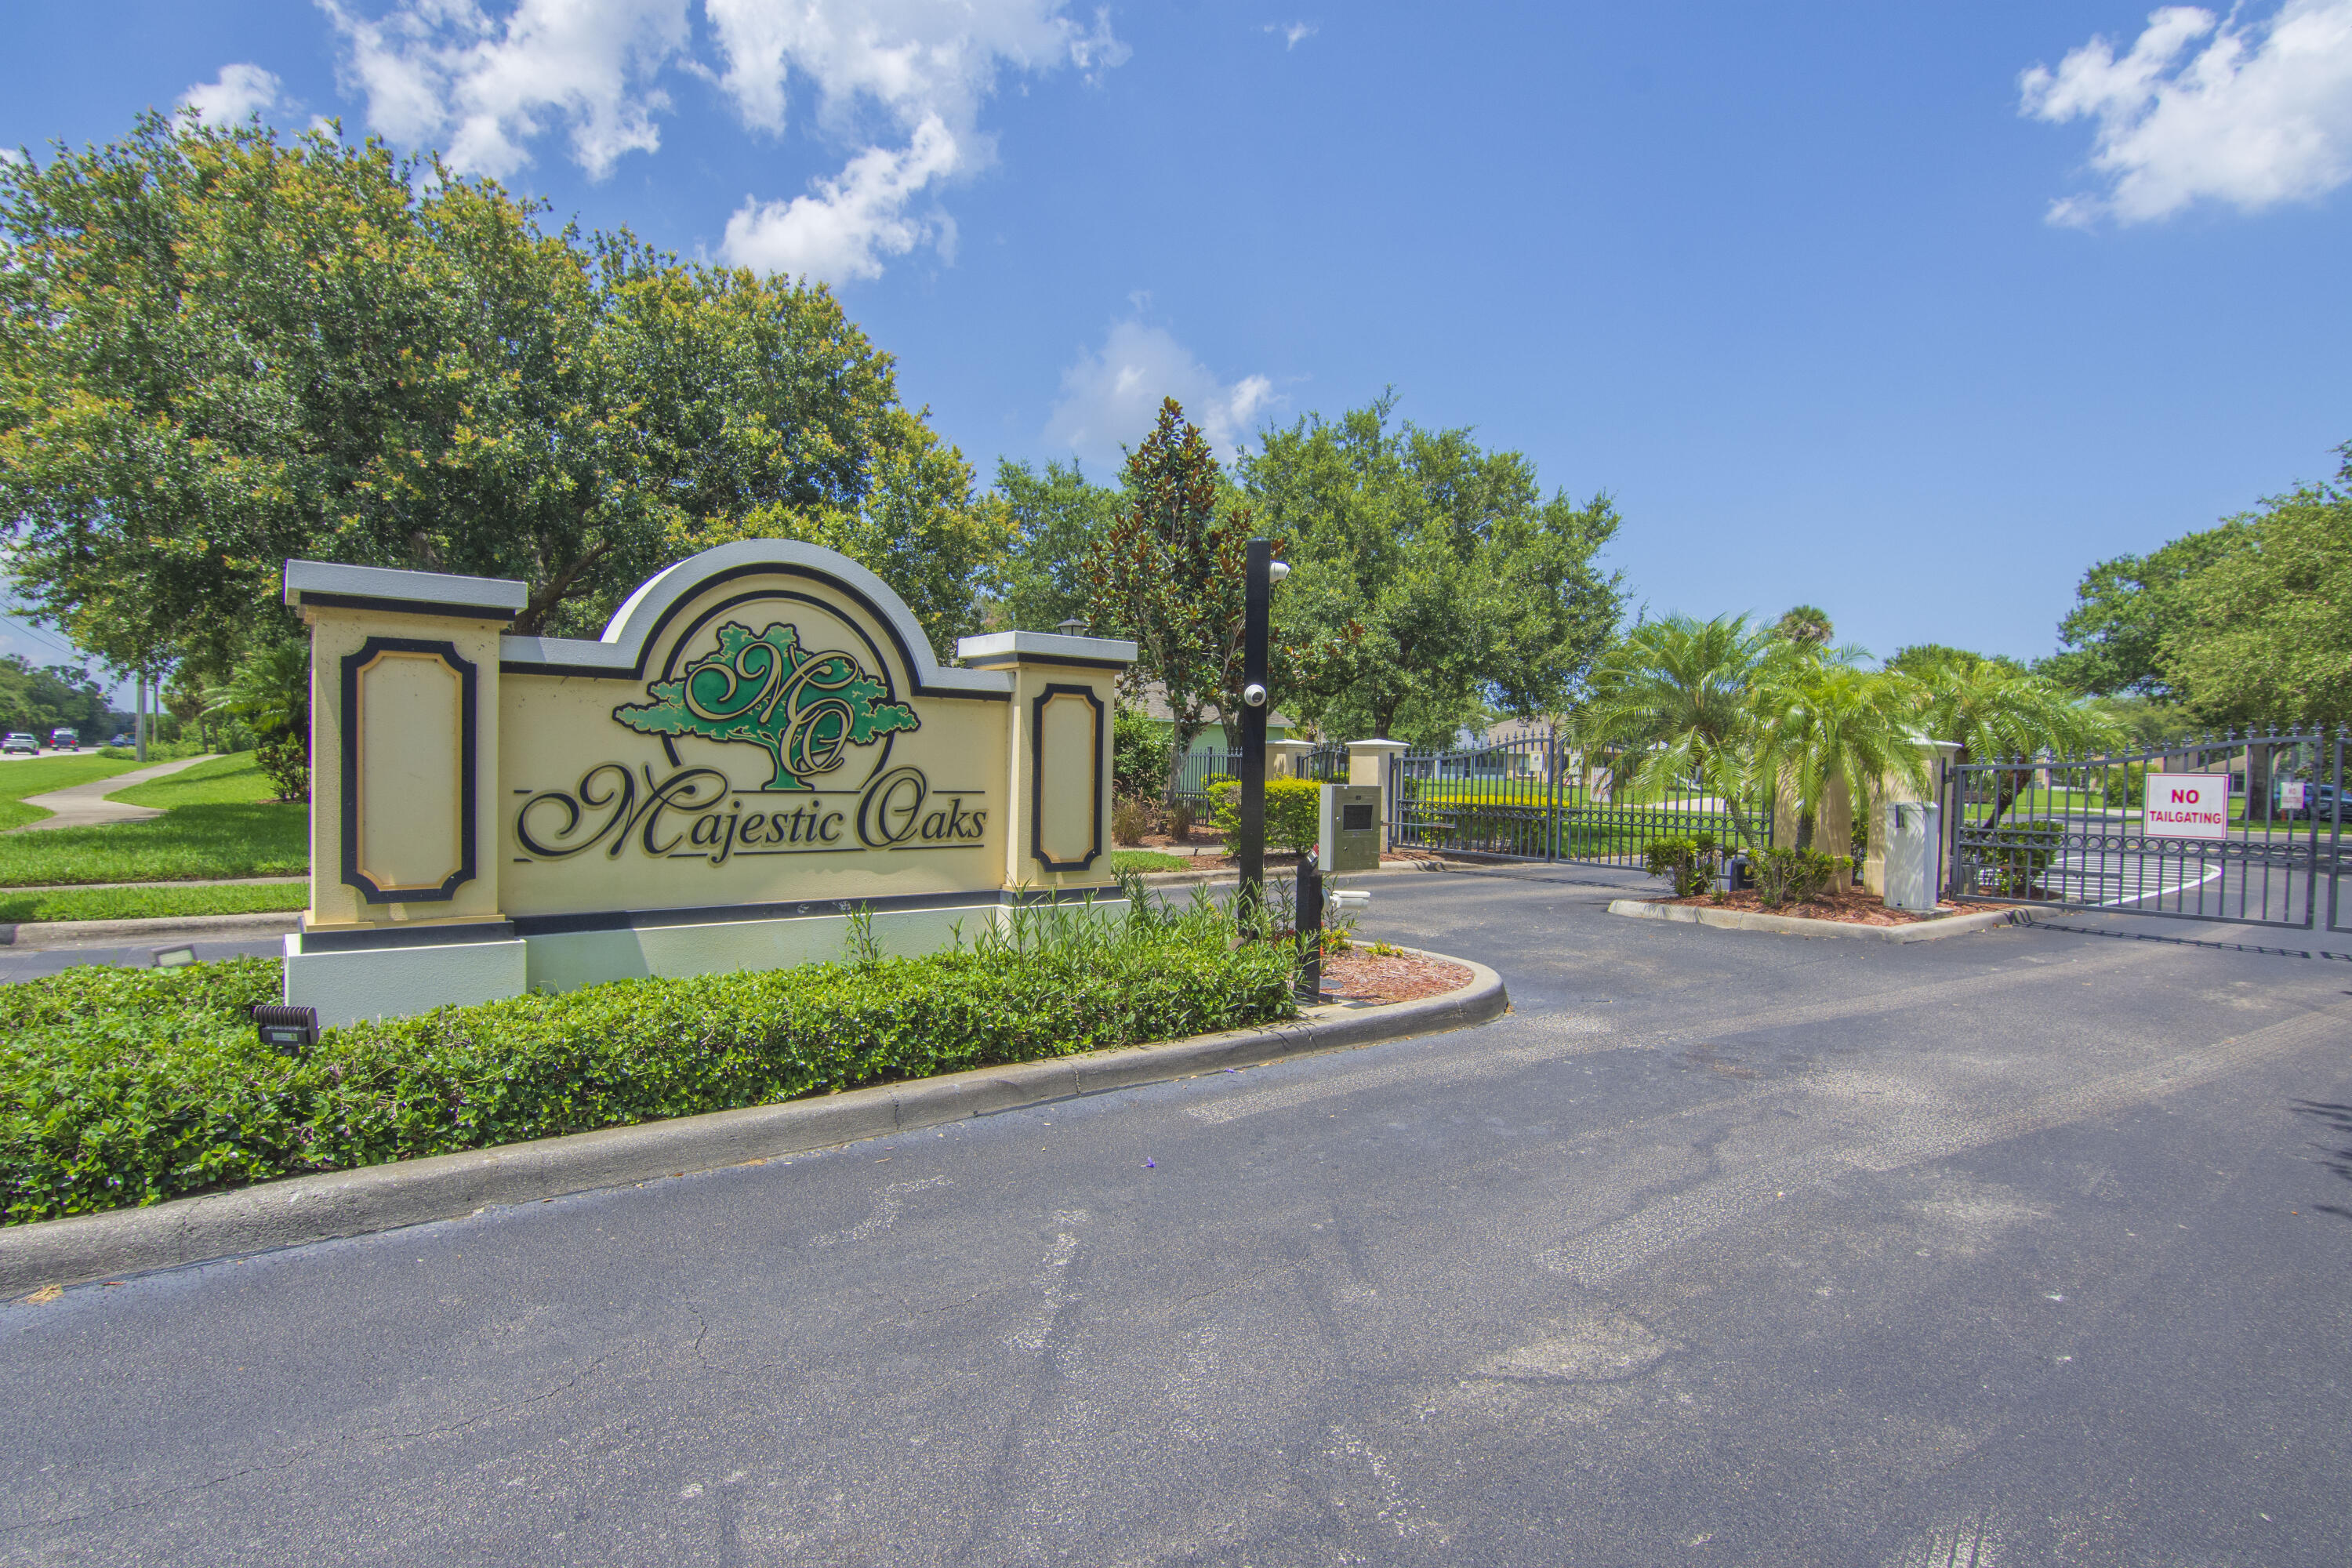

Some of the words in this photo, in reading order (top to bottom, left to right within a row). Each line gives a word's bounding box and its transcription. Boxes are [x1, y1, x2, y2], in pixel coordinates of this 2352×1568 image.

[2171, 789, 2200, 804] NO
[517, 764, 844, 863] Majestic
[857, 768, 986, 847] Oaks
[2149, 810, 2221, 824] TAILGATING
